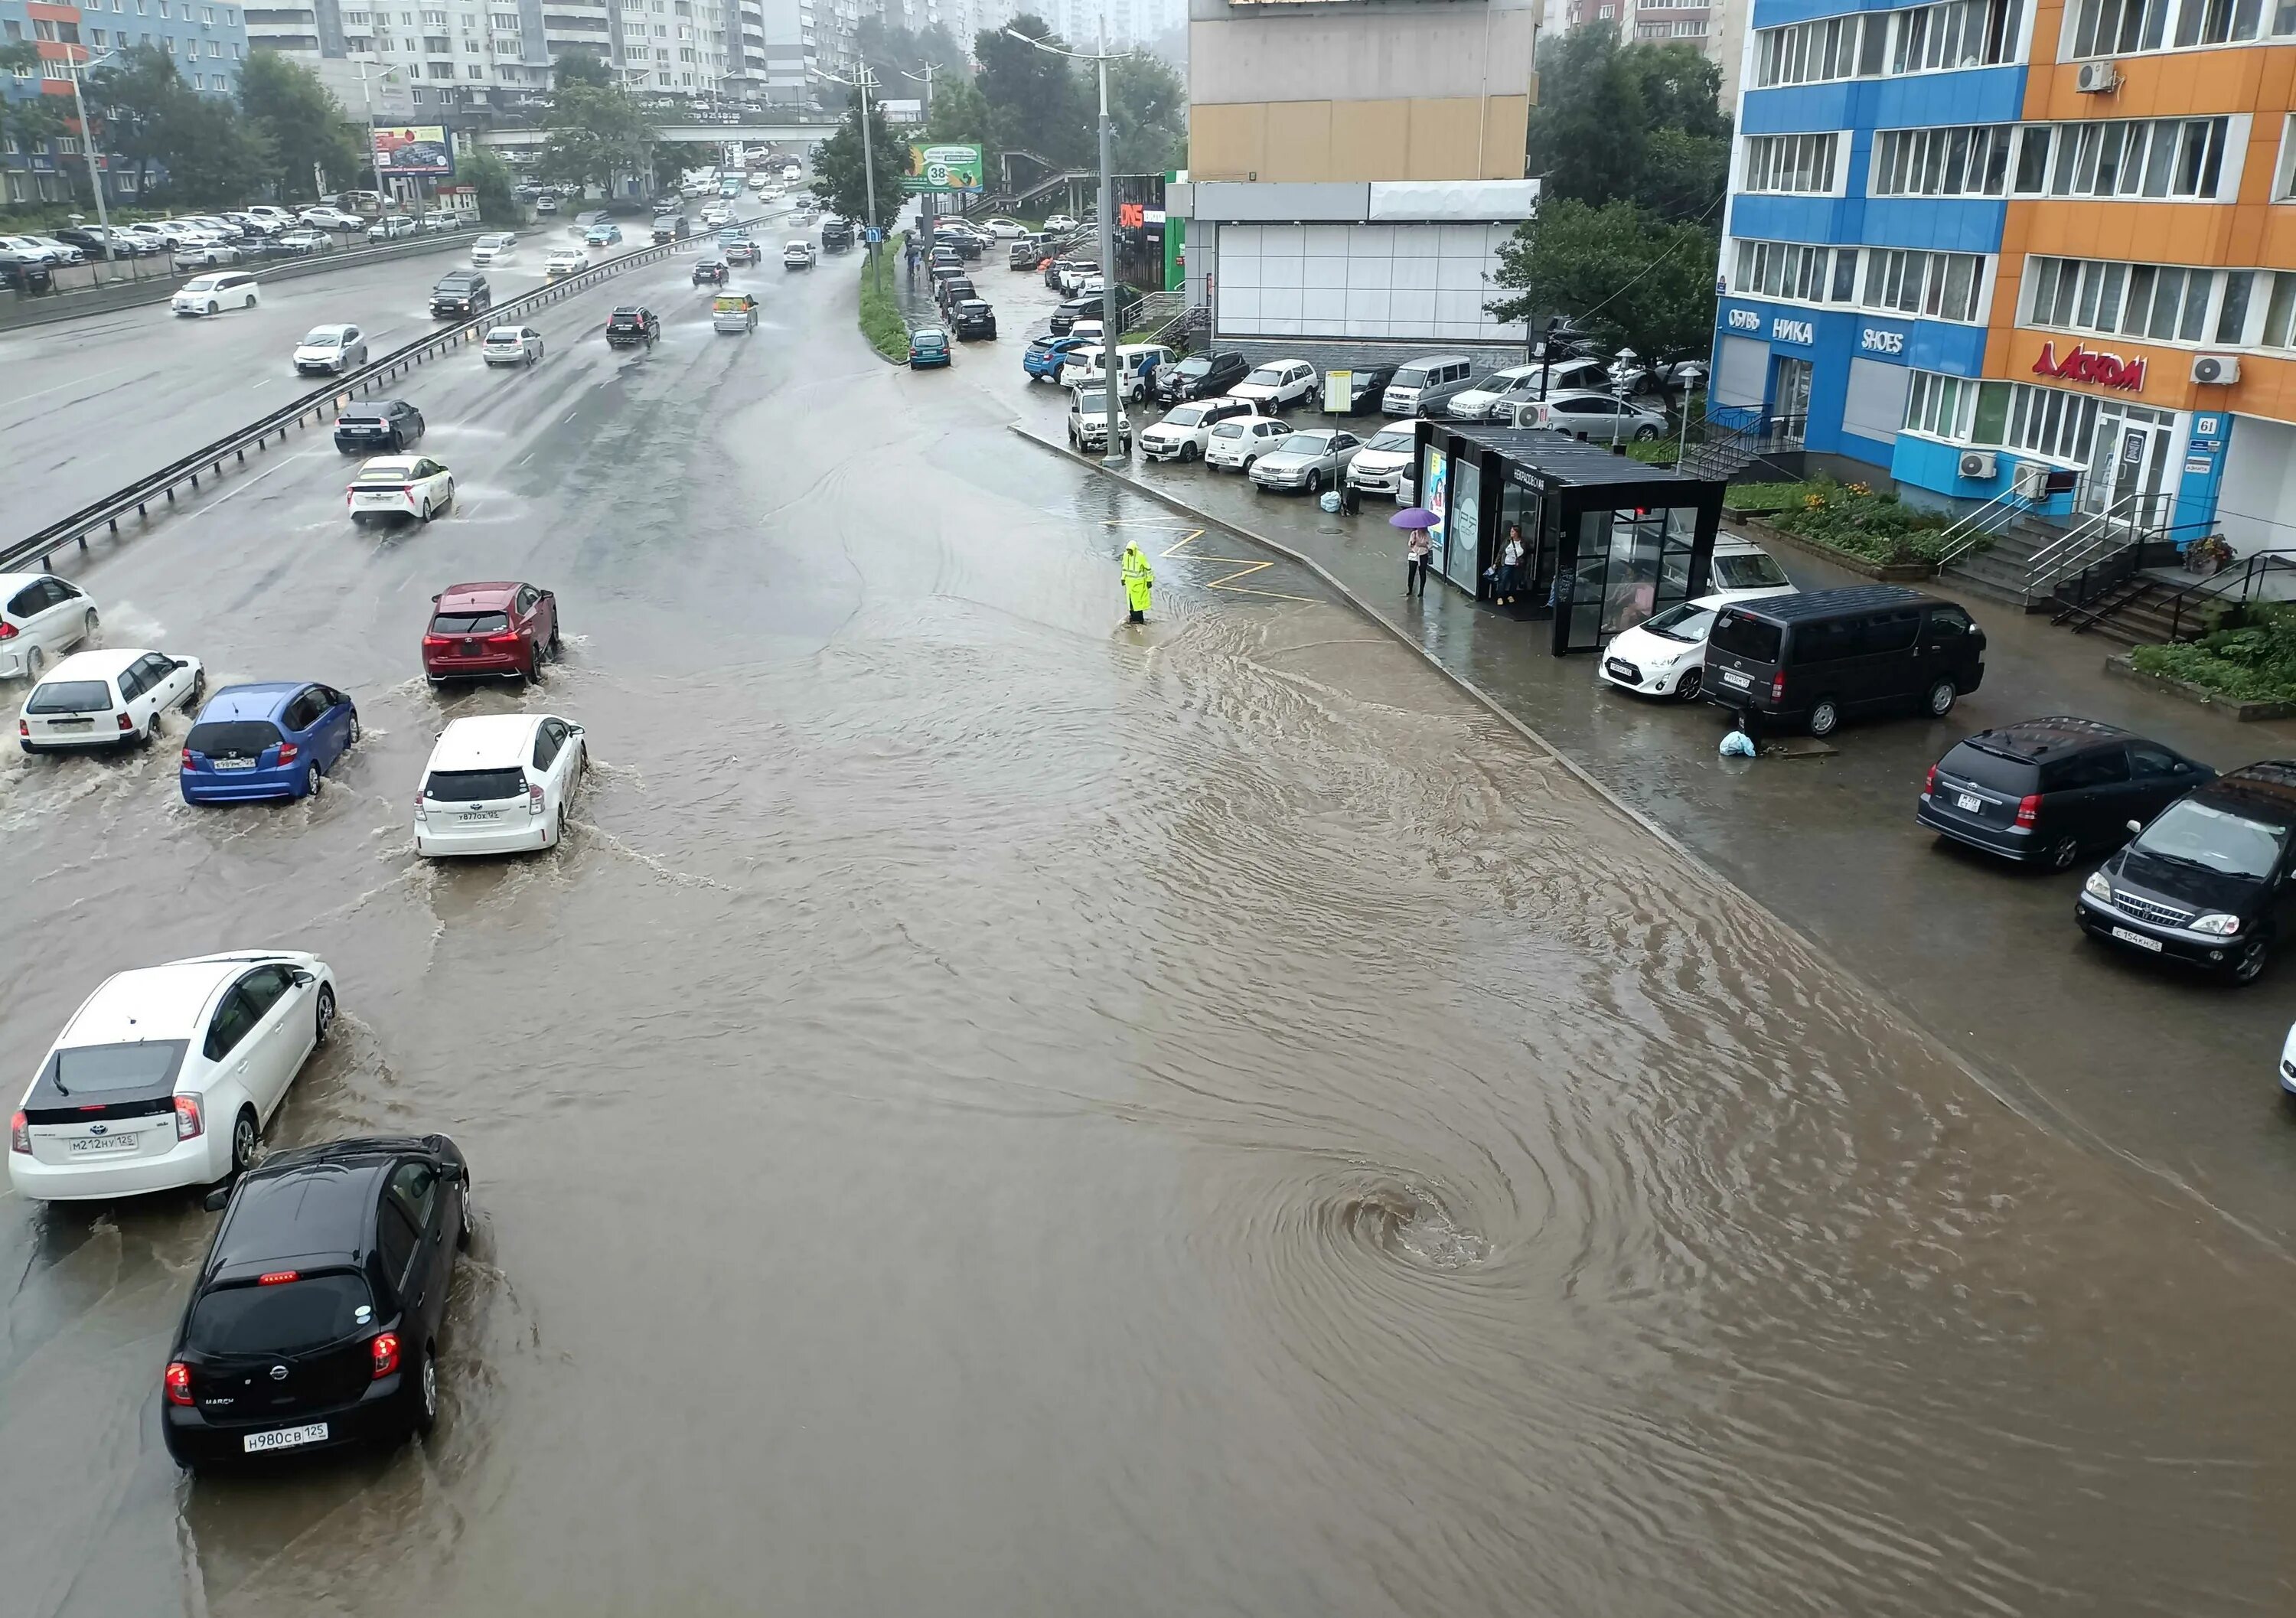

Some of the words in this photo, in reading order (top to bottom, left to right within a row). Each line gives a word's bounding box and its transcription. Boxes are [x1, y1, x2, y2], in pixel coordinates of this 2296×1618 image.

[931, 168, 945, 178] 38
[1120, 204, 1143, 227] DNS
[1728, 308, 1760, 330] ОБУВЬ
[1773, 318, 1813, 344] НИКА
[1861, 328, 1904, 353] SHOES
[2200, 420, 2213, 432] 61
